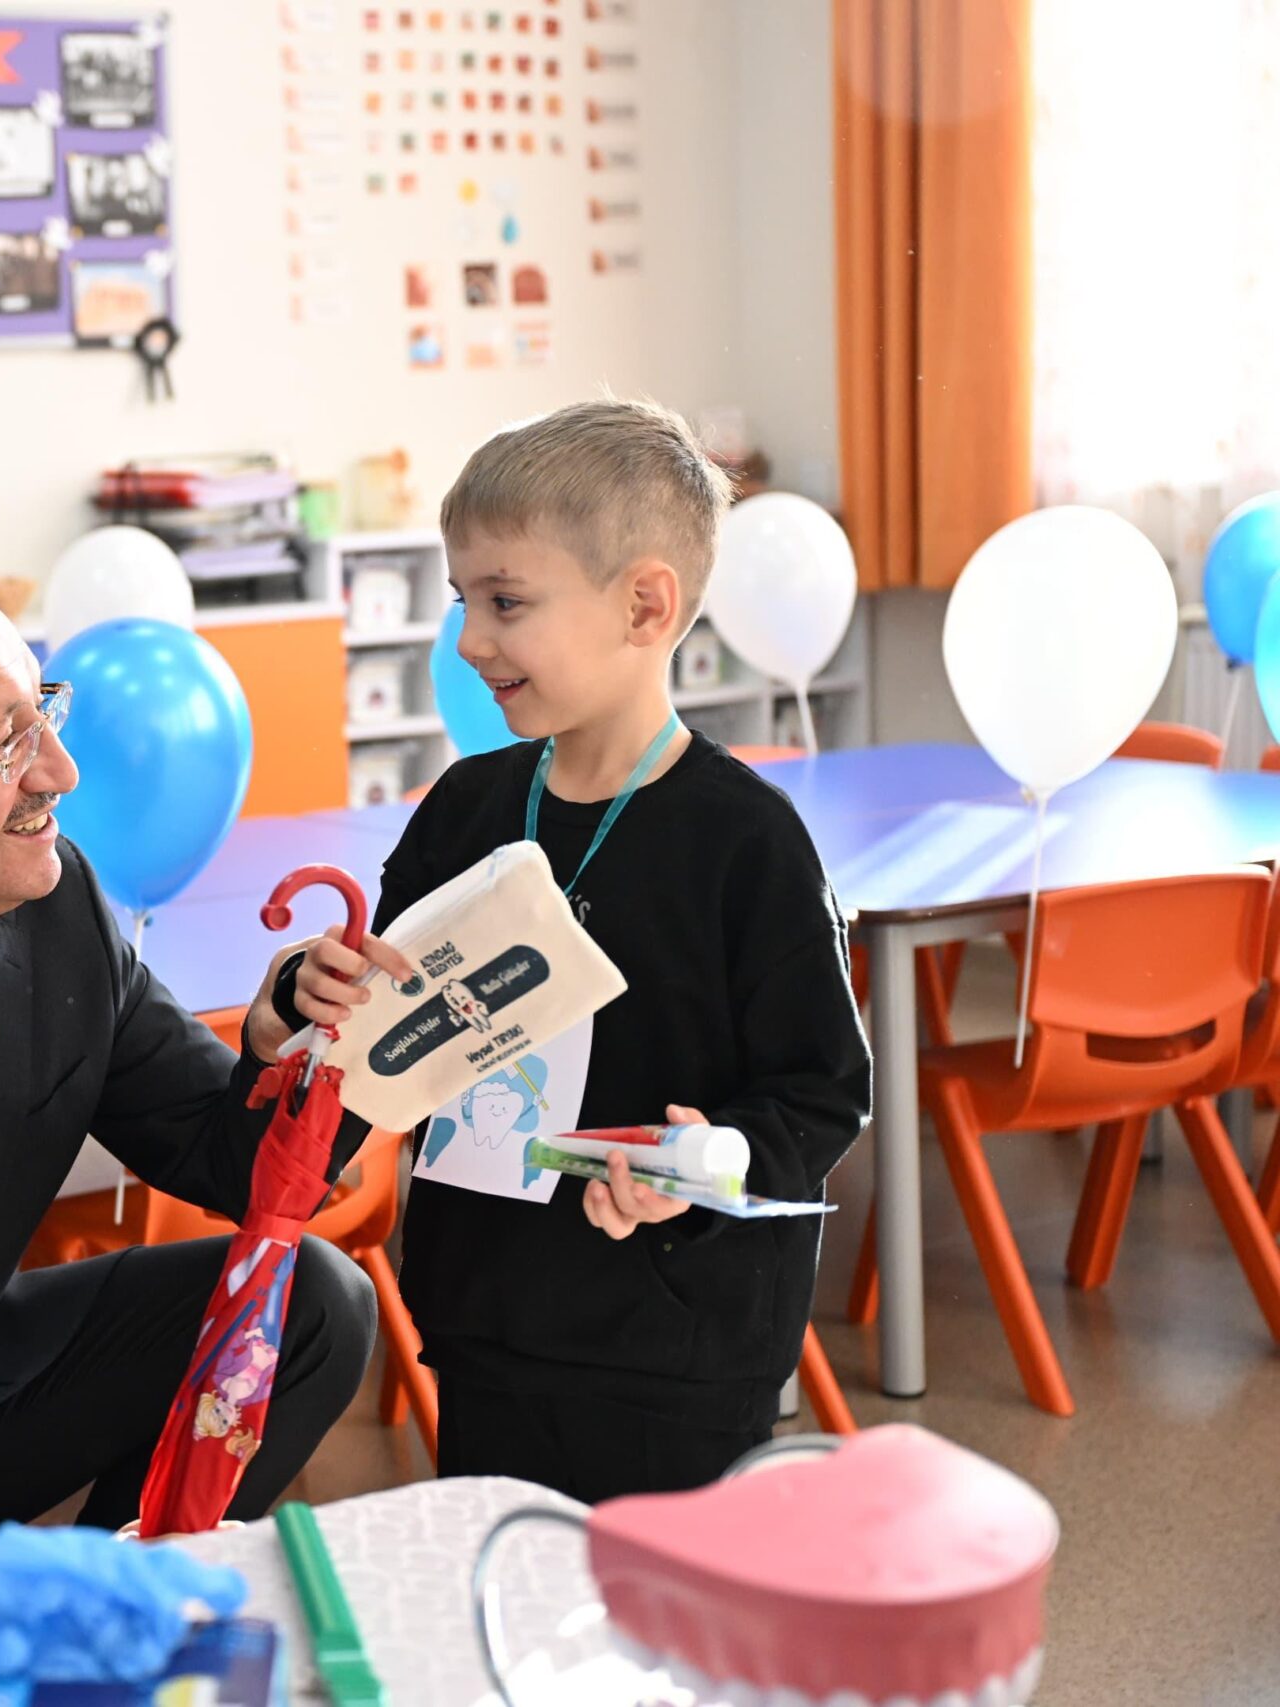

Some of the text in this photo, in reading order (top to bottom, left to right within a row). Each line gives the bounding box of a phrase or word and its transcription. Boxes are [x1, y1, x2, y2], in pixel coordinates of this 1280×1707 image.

[384, 1015, 442, 1062] Sağlıklı Dişler
[465, 1043, 494, 1065] Veysel
